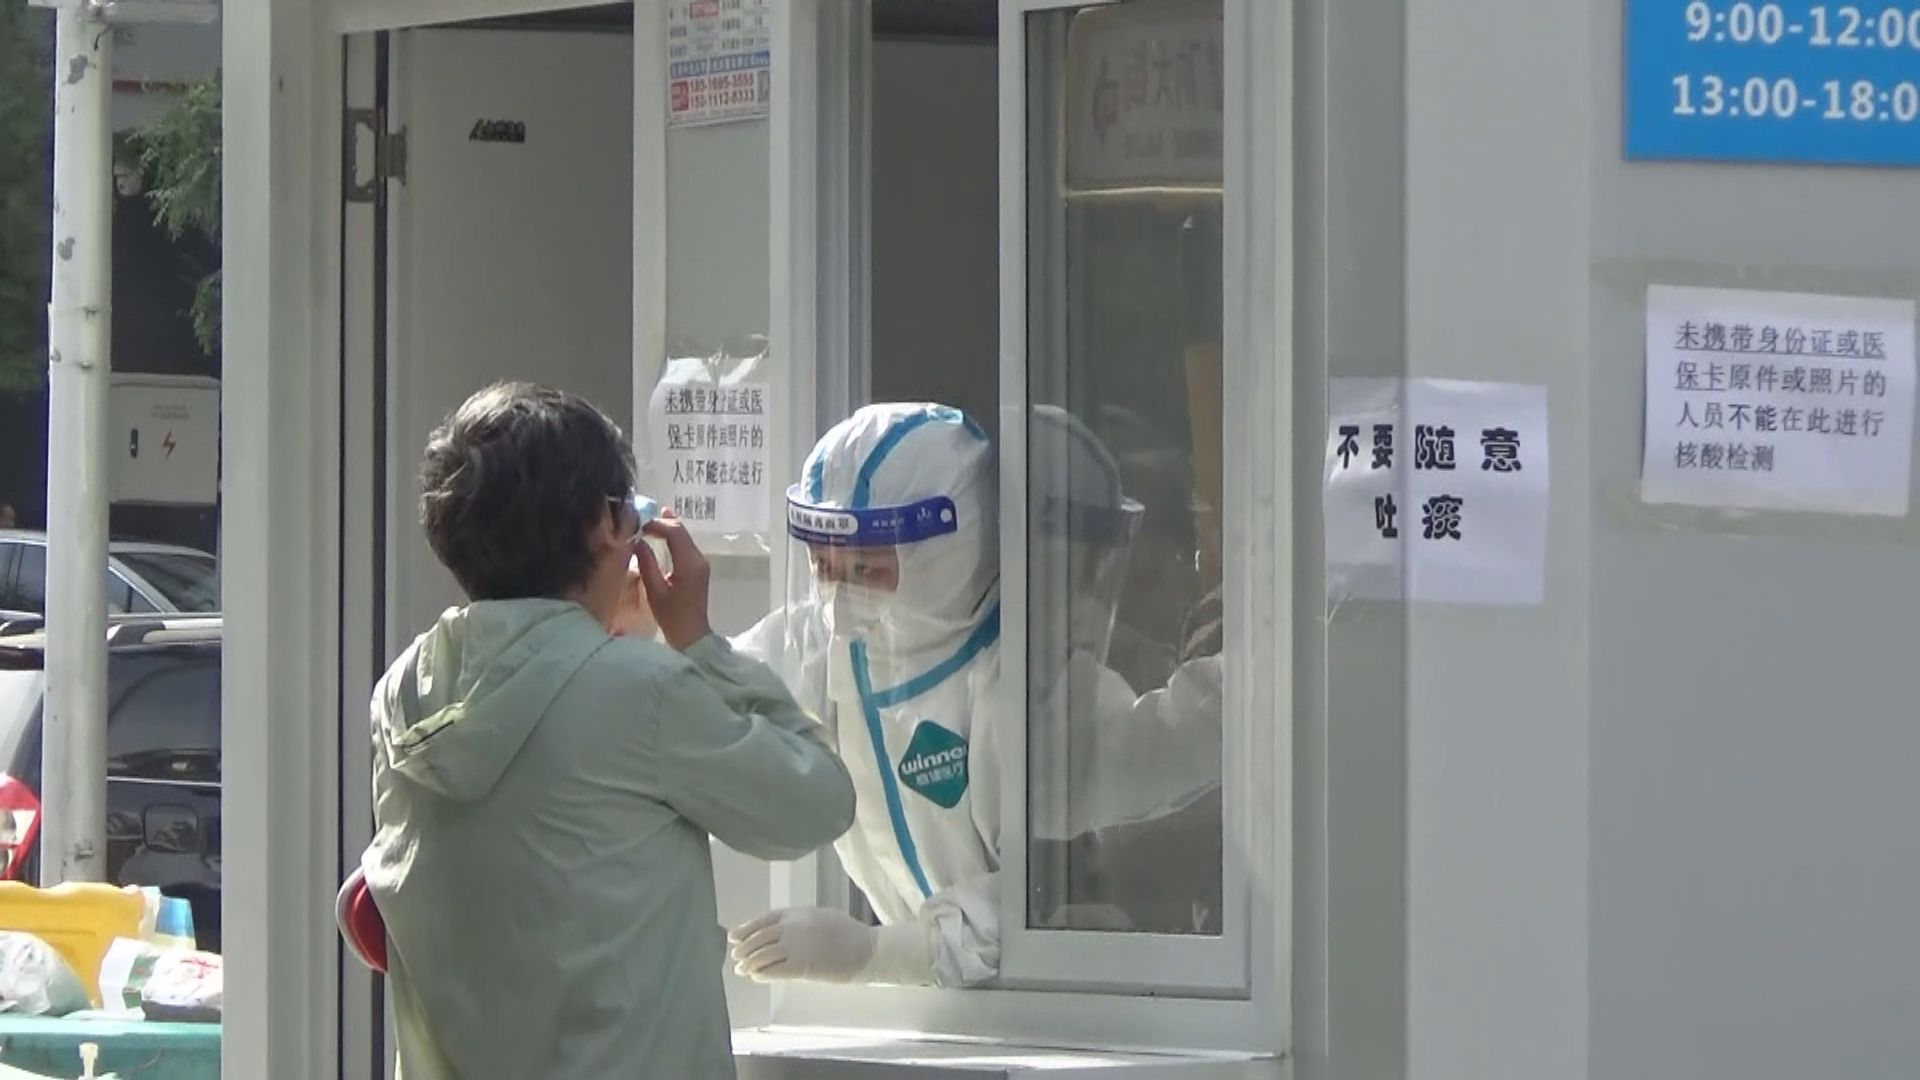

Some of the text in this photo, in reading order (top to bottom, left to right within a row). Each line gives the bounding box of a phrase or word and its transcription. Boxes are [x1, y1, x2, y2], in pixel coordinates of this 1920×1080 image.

[1674, 321, 1887, 360] 未携带身份证或医
[1674, 360, 1887, 398] 保卡原件或照片的
[1676, 401, 1884, 437] 人员不能在此进行
[1336, 423, 1522, 472] 不要随意
[1674, 441, 1775, 472] 核酸检测
[673, 459, 763, 485] 人员不能在此进行
[1374, 493, 1463, 542] 吐痰
